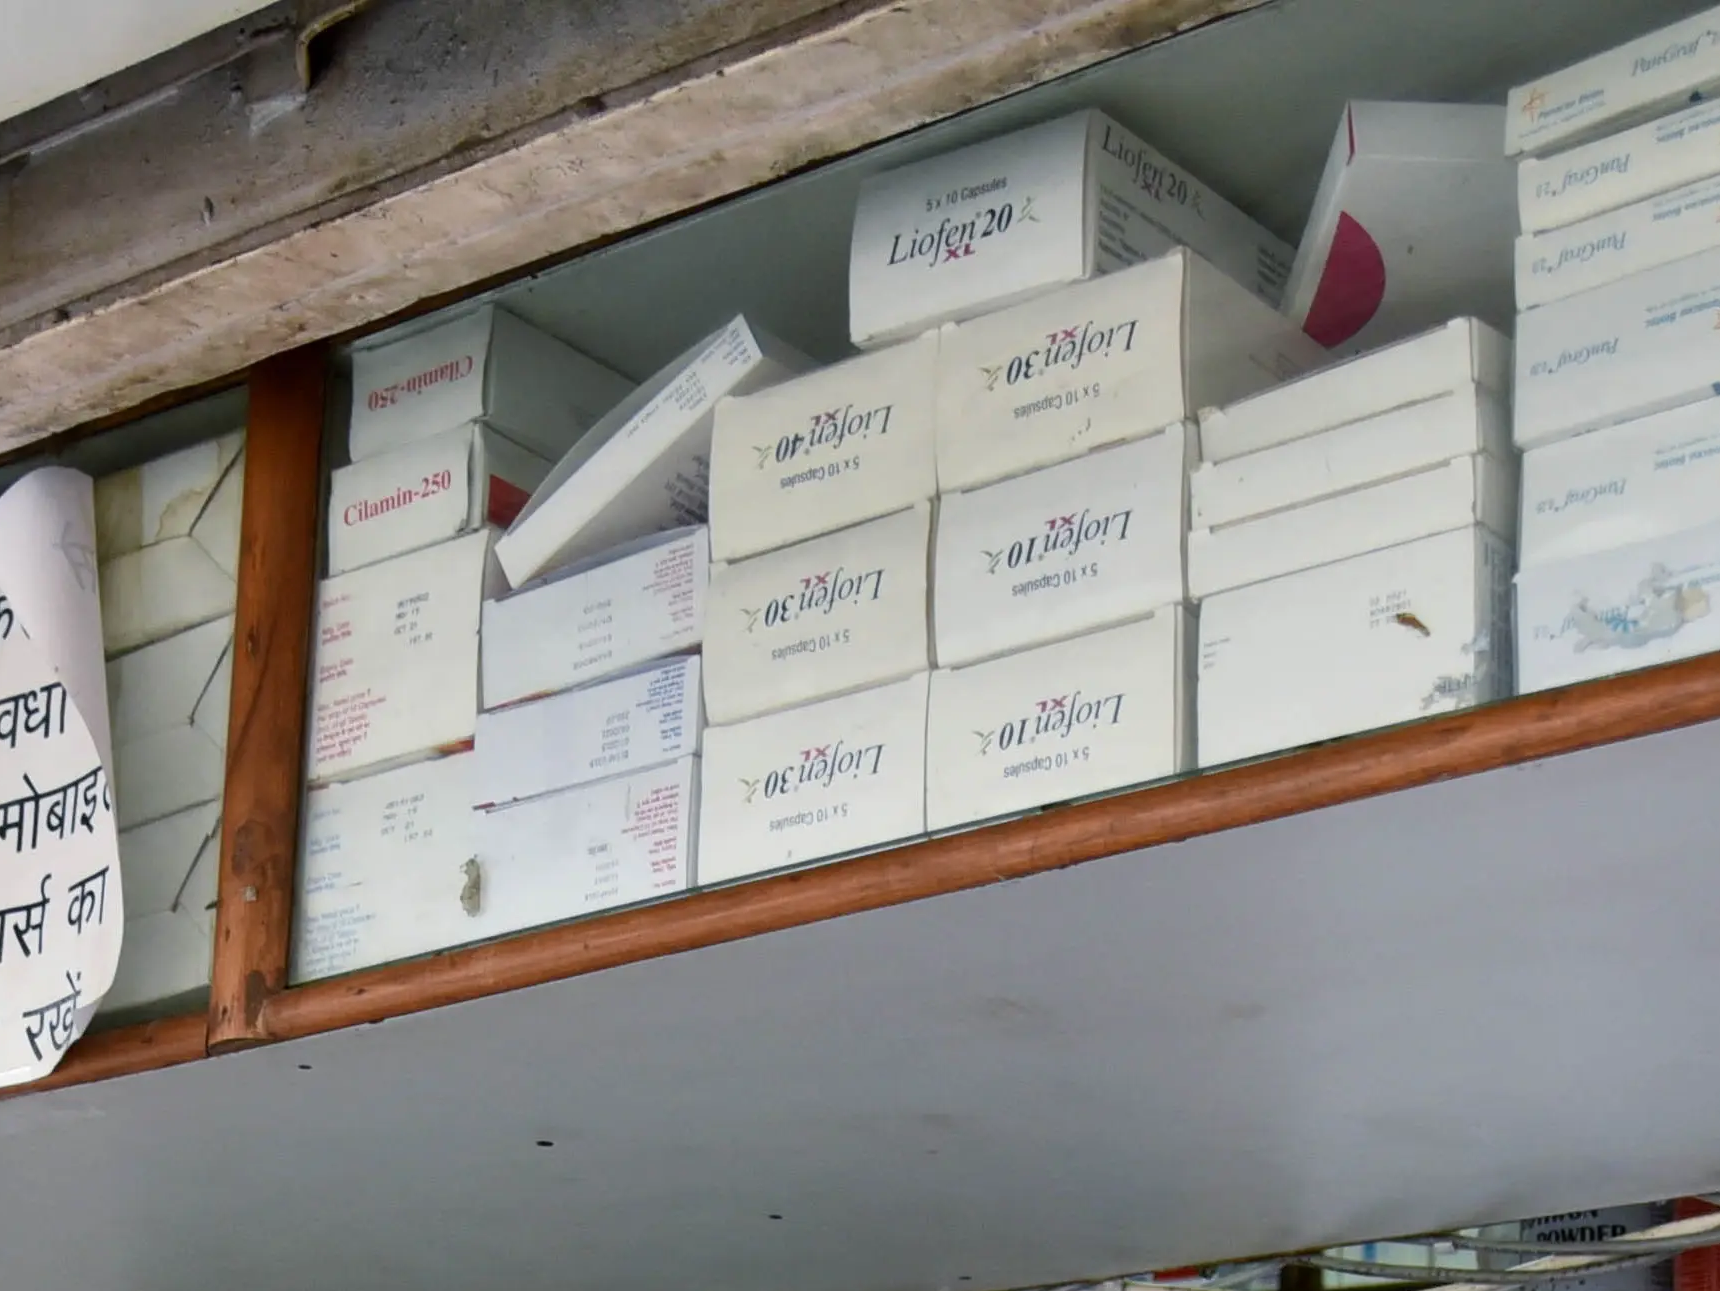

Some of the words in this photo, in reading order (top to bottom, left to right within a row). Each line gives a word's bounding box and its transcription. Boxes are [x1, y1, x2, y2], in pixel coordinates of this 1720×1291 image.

[960, 174, 1008, 203] Capsules
[887, 216, 977, 268] Liofen
[979, 202, 1013, 238] 20
[942, 243, 976, 263] XL
[1044, 319, 1140, 370] Liofen
[1045, 324, 1080, 346] XL
[367, 354, 475, 412] Cilamin-250
[1006, 352, 1038, 386] 30
[809, 408, 842, 429] XL
[1012, 391, 1064, 421] Capsules
[807, 403, 895, 451] Liofen
[775, 431, 807, 465] 40
[779, 464, 826, 490] Capsules
[342, 468, 453, 527] Cilamin-250
[1037, 508, 1135, 561] Liofen
[1043, 513, 1077, 533] XL
[1007, 536, 1035, 570] 10
[792, 568, 887, 621] Liofen
[799, 570, 832, 590] XL
[1010, 570, 1062, 598] Capsules
[763, 597, 793, 629] 30
[769, 636, 816, 663] Capsules
[1028, 692, 1127, 744] Liofen
[1035, 695, 1069, 715] XL
[997, 719, 1027, 752] 10
[792, 743, 887, 793] Liofen
[799, 744, 832, 764] XL
[1003, 753, 1053, 780] Capsules
[763, 767, 793, 800] 30
[768, 809, 814, 834] Capsules
[66, 864, 110, 936] का
[22, 970, 83, 1062] रखें
